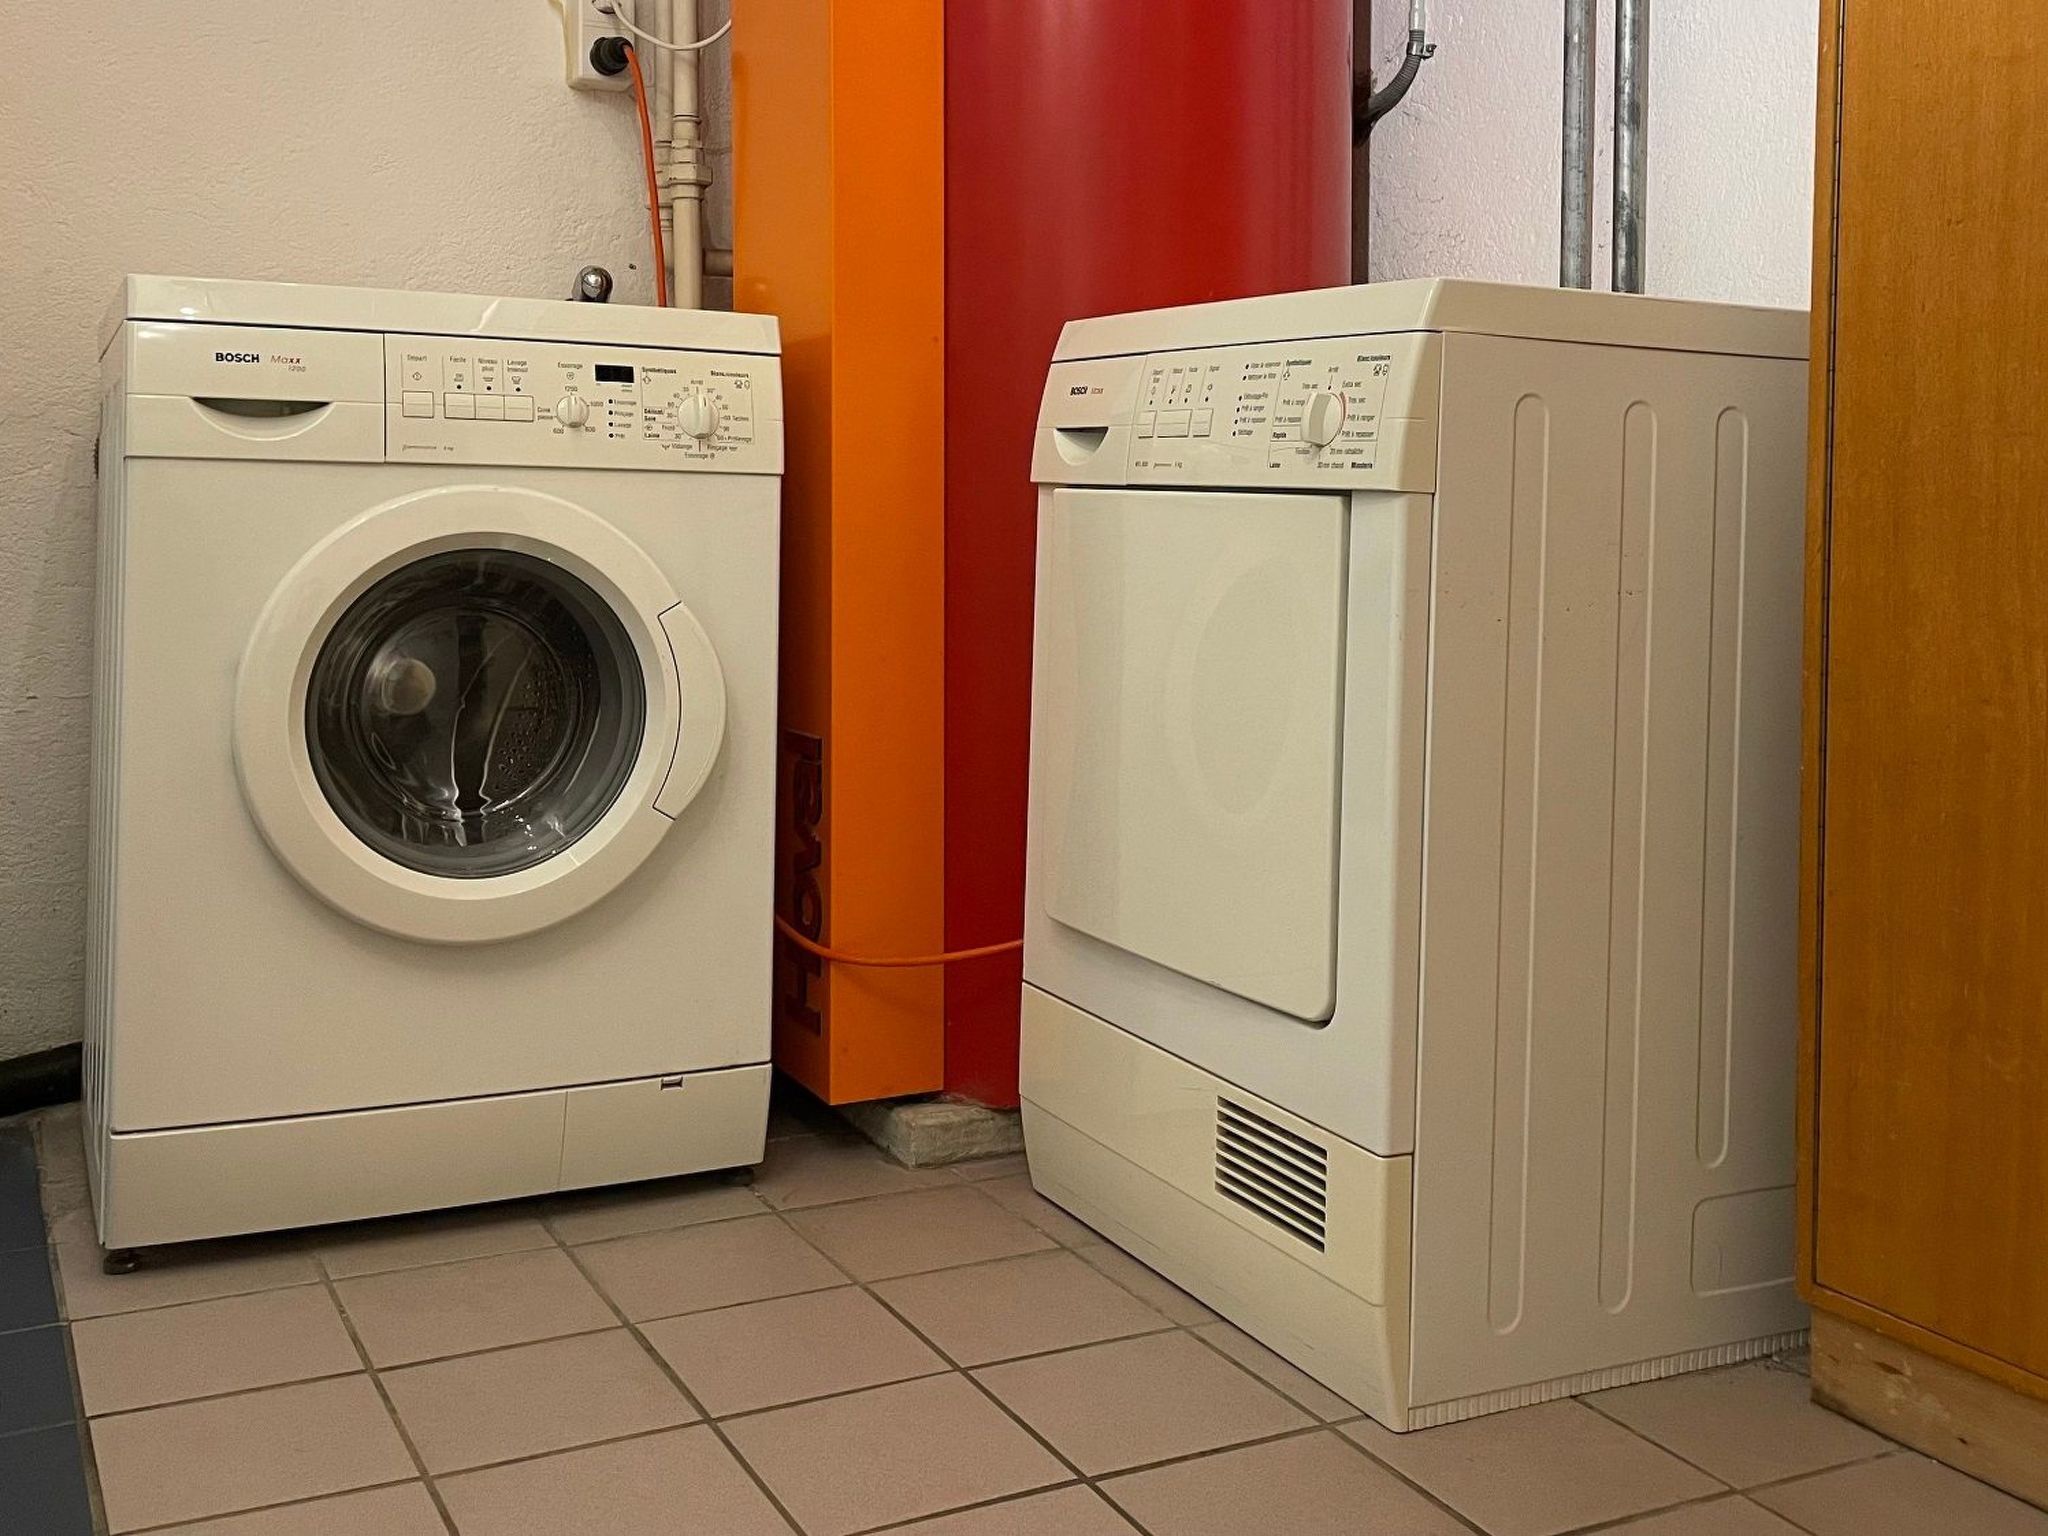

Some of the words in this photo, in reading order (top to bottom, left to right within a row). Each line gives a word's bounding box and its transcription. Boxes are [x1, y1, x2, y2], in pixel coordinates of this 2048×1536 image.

[215, 352, 260, 363] BOSCH
[271, 355, 301, 364] Maxx
[782, 730, 823, 1038] Hoval
